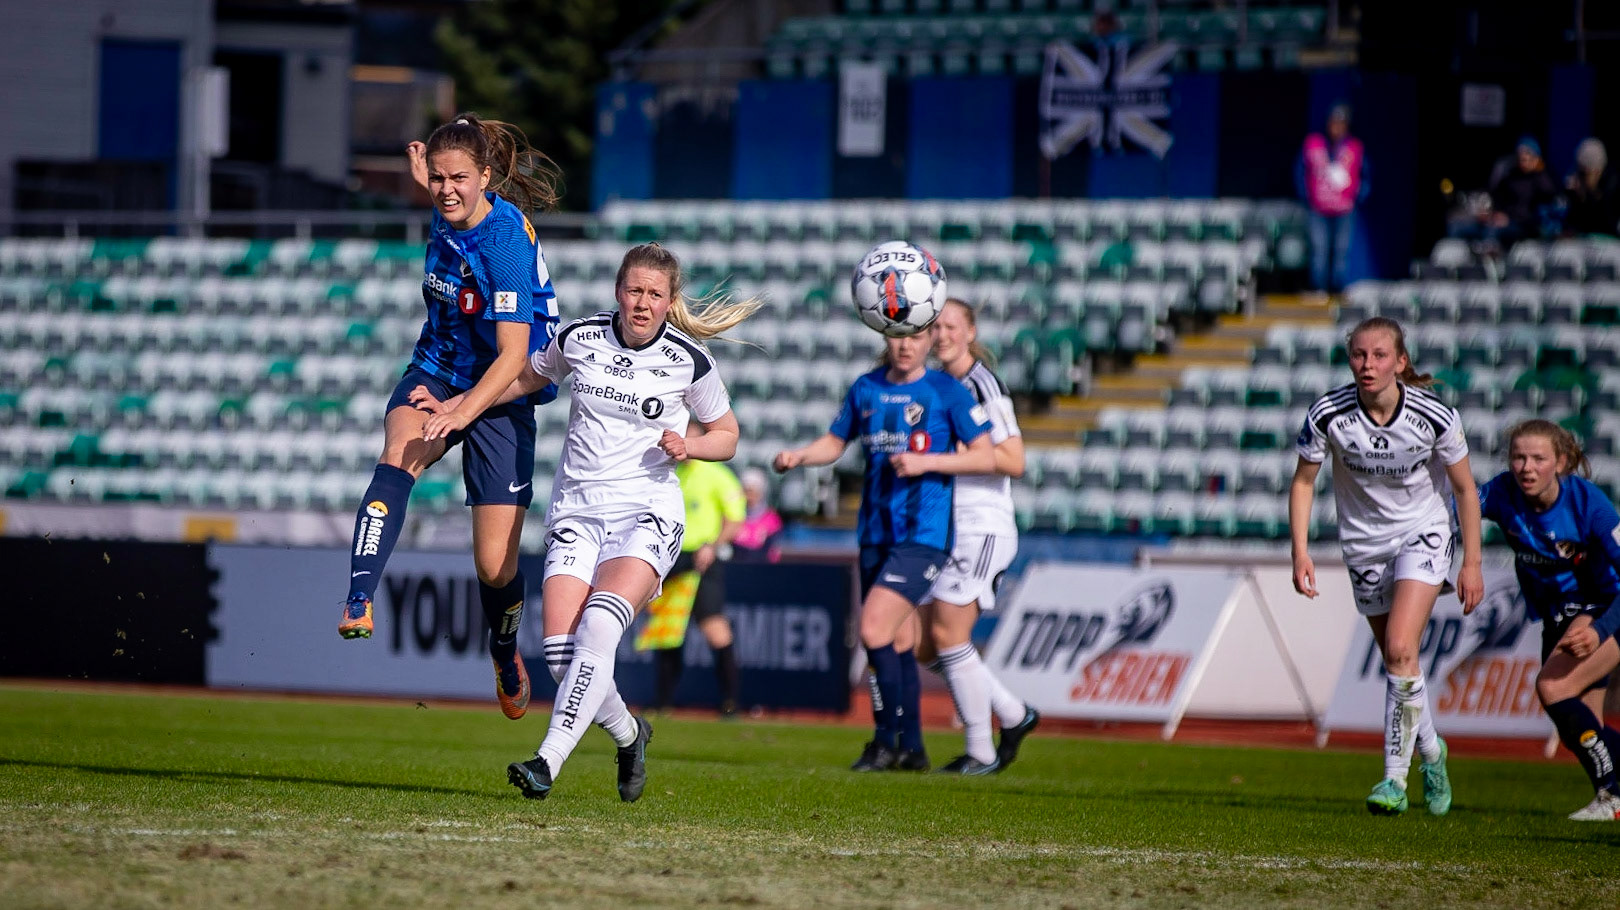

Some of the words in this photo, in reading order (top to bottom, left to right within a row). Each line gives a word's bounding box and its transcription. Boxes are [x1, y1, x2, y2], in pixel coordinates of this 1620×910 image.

[868, 251, 917, 268] SELECT
[577, 329, 608, 342] HENT
[659, 343, 685, 365] HENT
[604, 365, 635, 380] OBOS
[573, 378, 640, 407] SpareBank
[618, 405, 638, 415] SMN
[1405, 413, 1430, 432] HENT
[1365, 451, 1395, 460] OBOS
[563, 554, 576, 567] 27
[384, 573, 489, 655] YOU
[1003, 610, 1107, 671] TOPP
[1070, 651, 1194, 705] SERIEN
[1437, 656, 1547, 716] SERIE
[562, 661, 595, 731] RAMIRENT
[1391, 700, 1404, 757] RAMIREN
